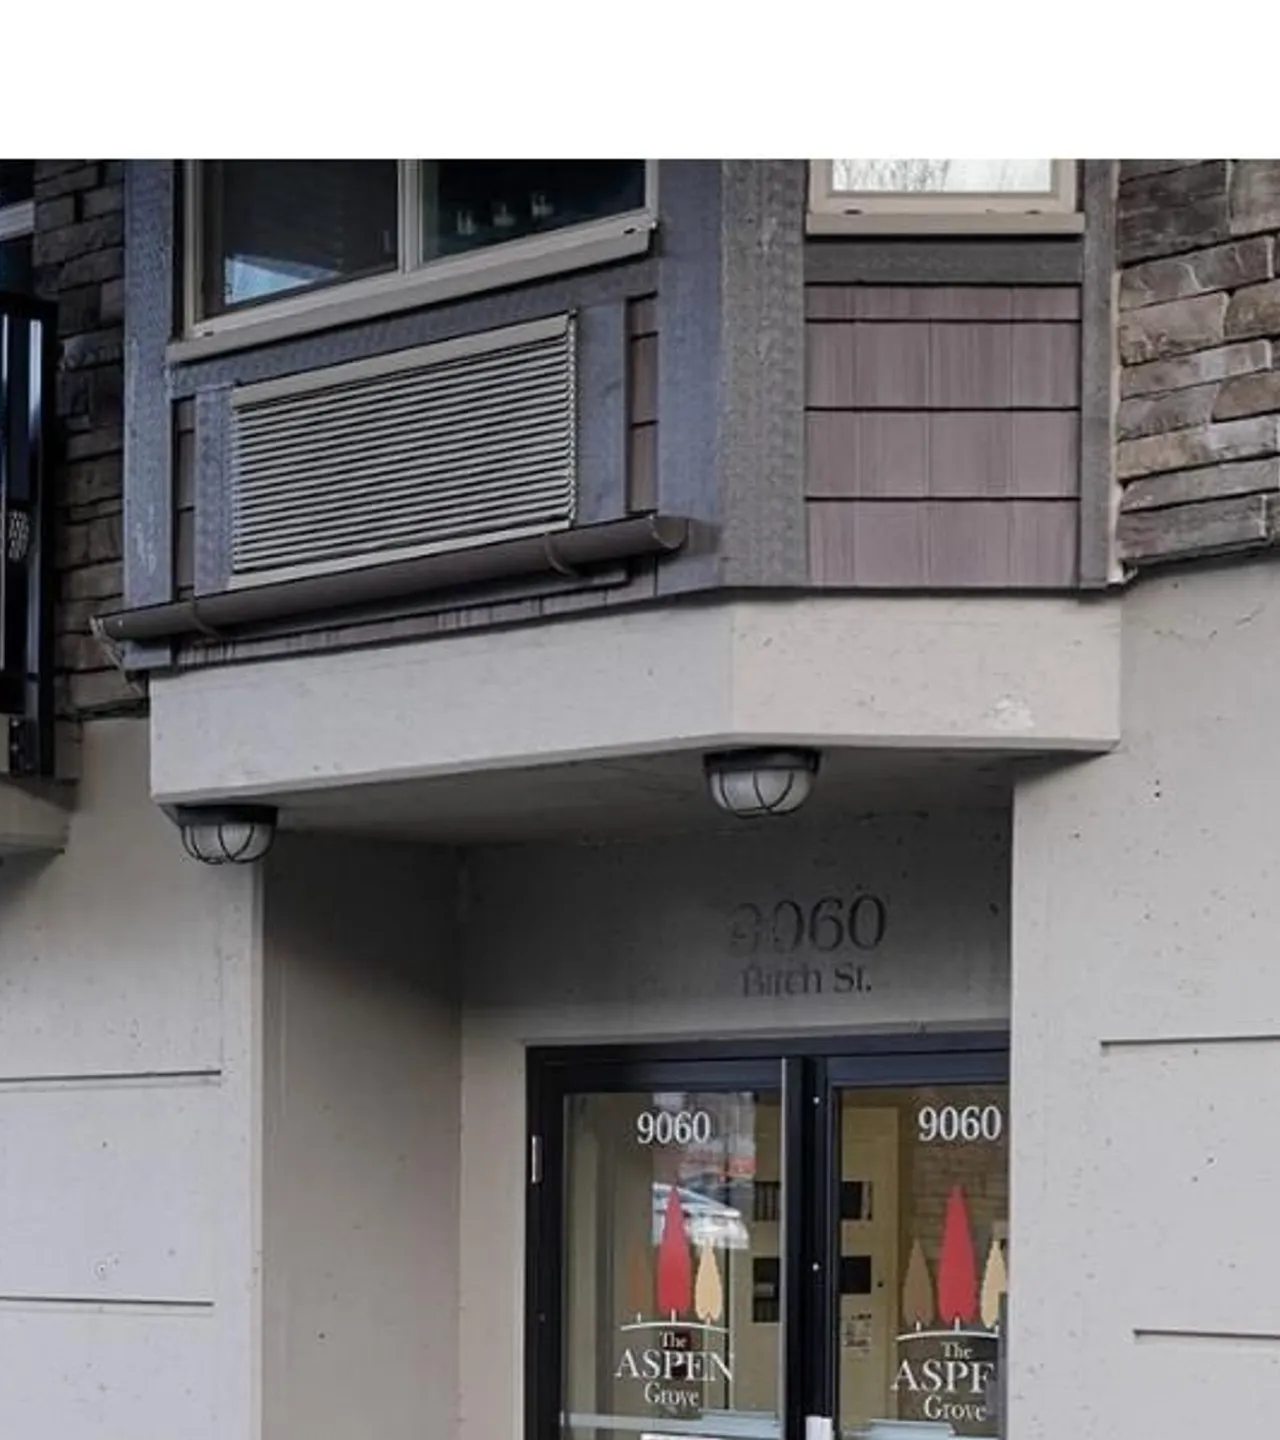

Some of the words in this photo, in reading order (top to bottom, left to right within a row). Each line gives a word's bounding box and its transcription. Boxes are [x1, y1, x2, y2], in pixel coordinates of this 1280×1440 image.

[636, 1110, 712, 1145] 9060
[918, 1105, 1002, 1141] 9060
[660, 1331, 687, 1349] The
[941, 1341, 973, 1360] The
[613, 1348, 734, 1381] ASPEN
[644, 1381, 700, 1407] Grove
[924, 1394, 987, 1421] Grove
